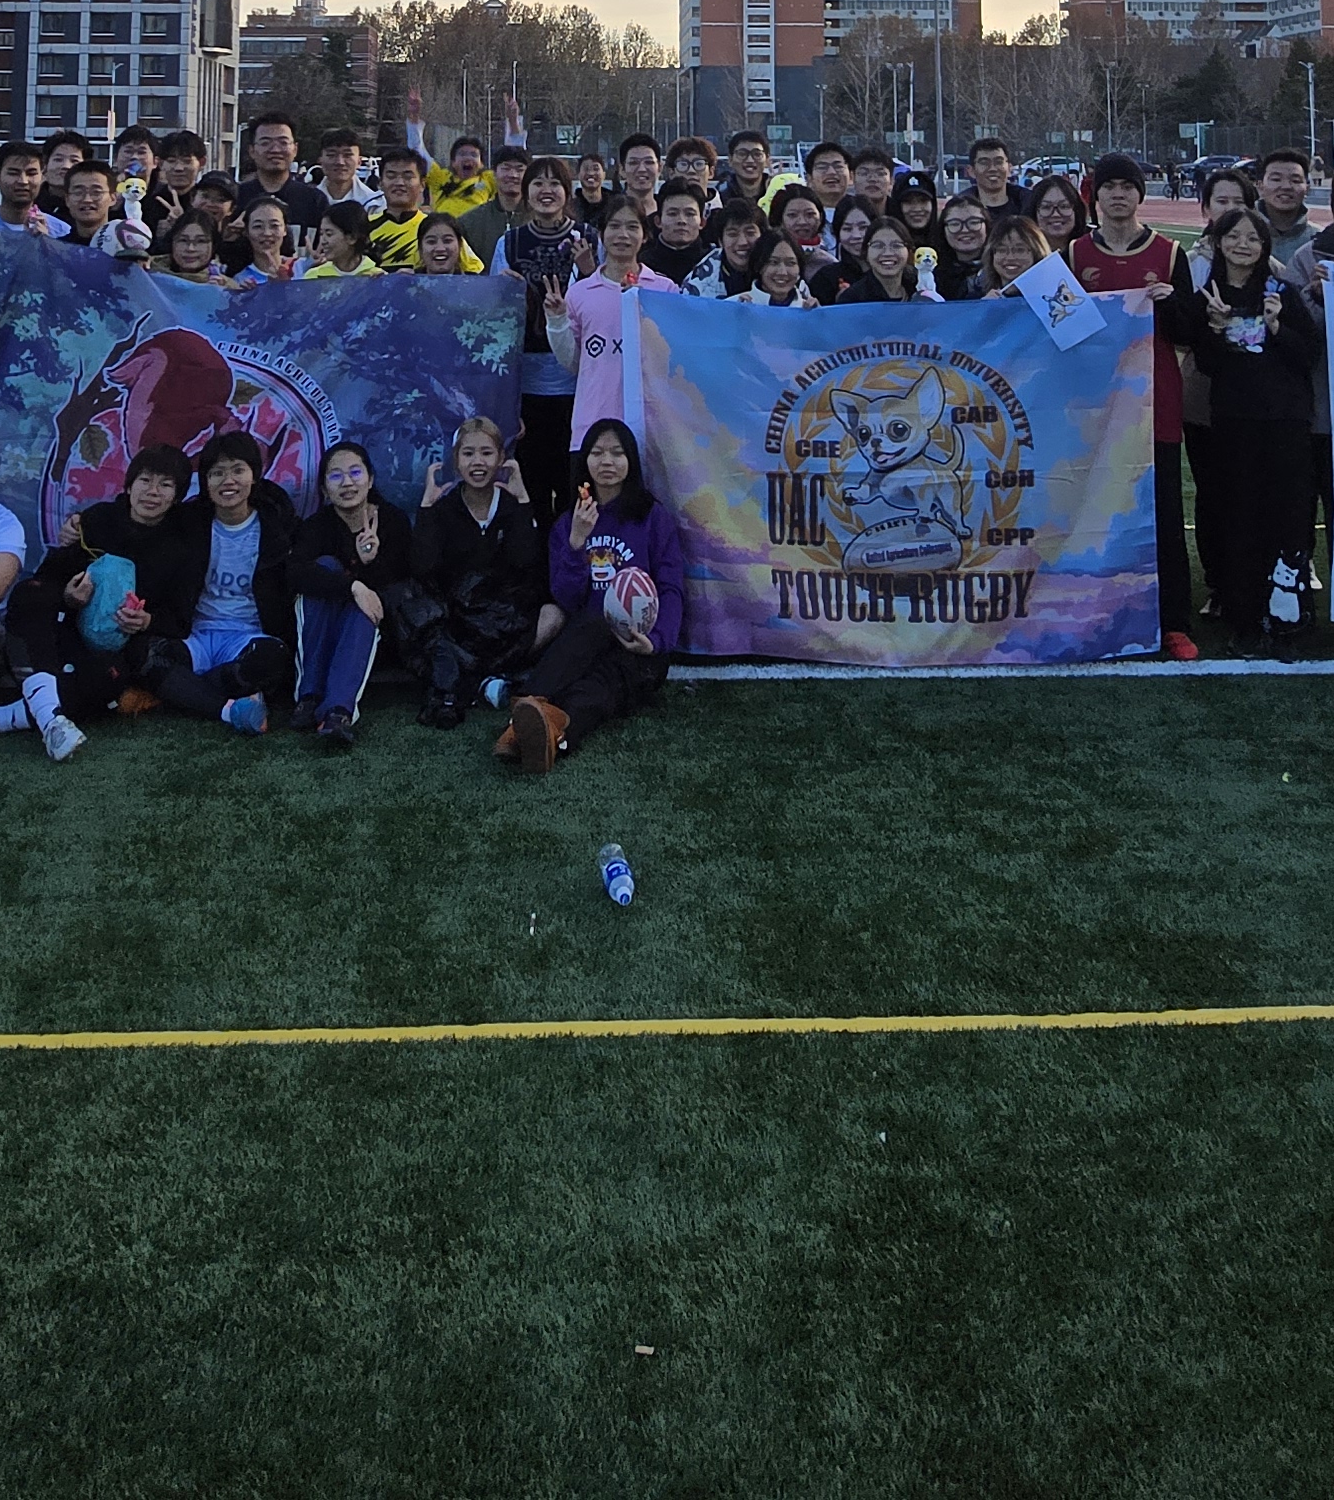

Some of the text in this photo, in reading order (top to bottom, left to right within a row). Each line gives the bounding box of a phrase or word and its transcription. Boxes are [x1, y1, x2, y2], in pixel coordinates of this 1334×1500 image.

[217, 342, 340, 444] CHINA AGRICULTURA
[764, 342, 1035, 454] CHINA AGRICULTURAL UNIVERSITY
[951, 405, 999, 425] CAB
[794, 439, 841, 459] CRE
[985, 469, 1035, 489] COH
[766, 472, 826, 546] UAC
[987, 528, 1035, 546] CPP
[771, 569, 1036, 624] TOUCH RUGBY
